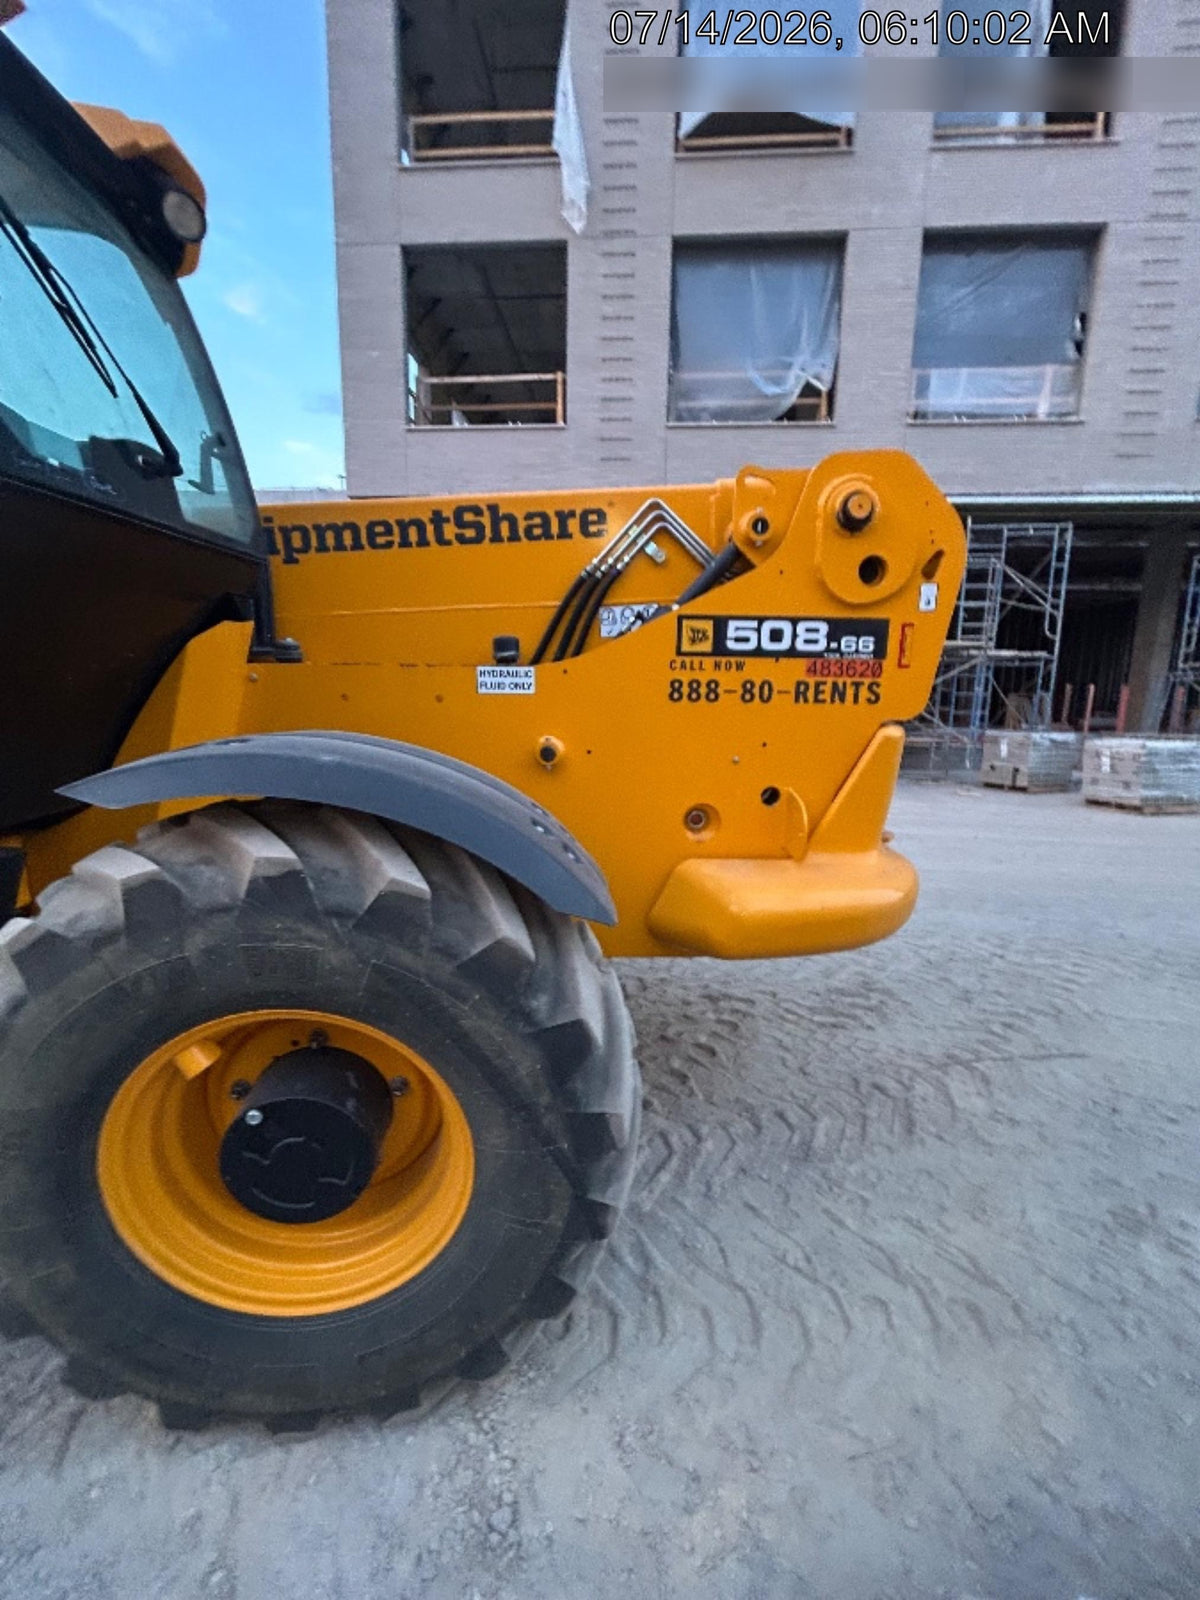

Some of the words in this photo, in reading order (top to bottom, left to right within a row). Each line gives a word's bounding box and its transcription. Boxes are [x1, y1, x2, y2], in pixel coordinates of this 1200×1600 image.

[669, 659, 706, 671] CALL
[713, 660, 746, 671] NOW
[806, 660, 883, 678] 483620
[479, 669, 532, 678] HYDRAULIC
[479, 681, 506, 690] FLUID
[508, 682, 532, 690] ONLY
[668, 679, 881, 705] 888-80-RENTS
